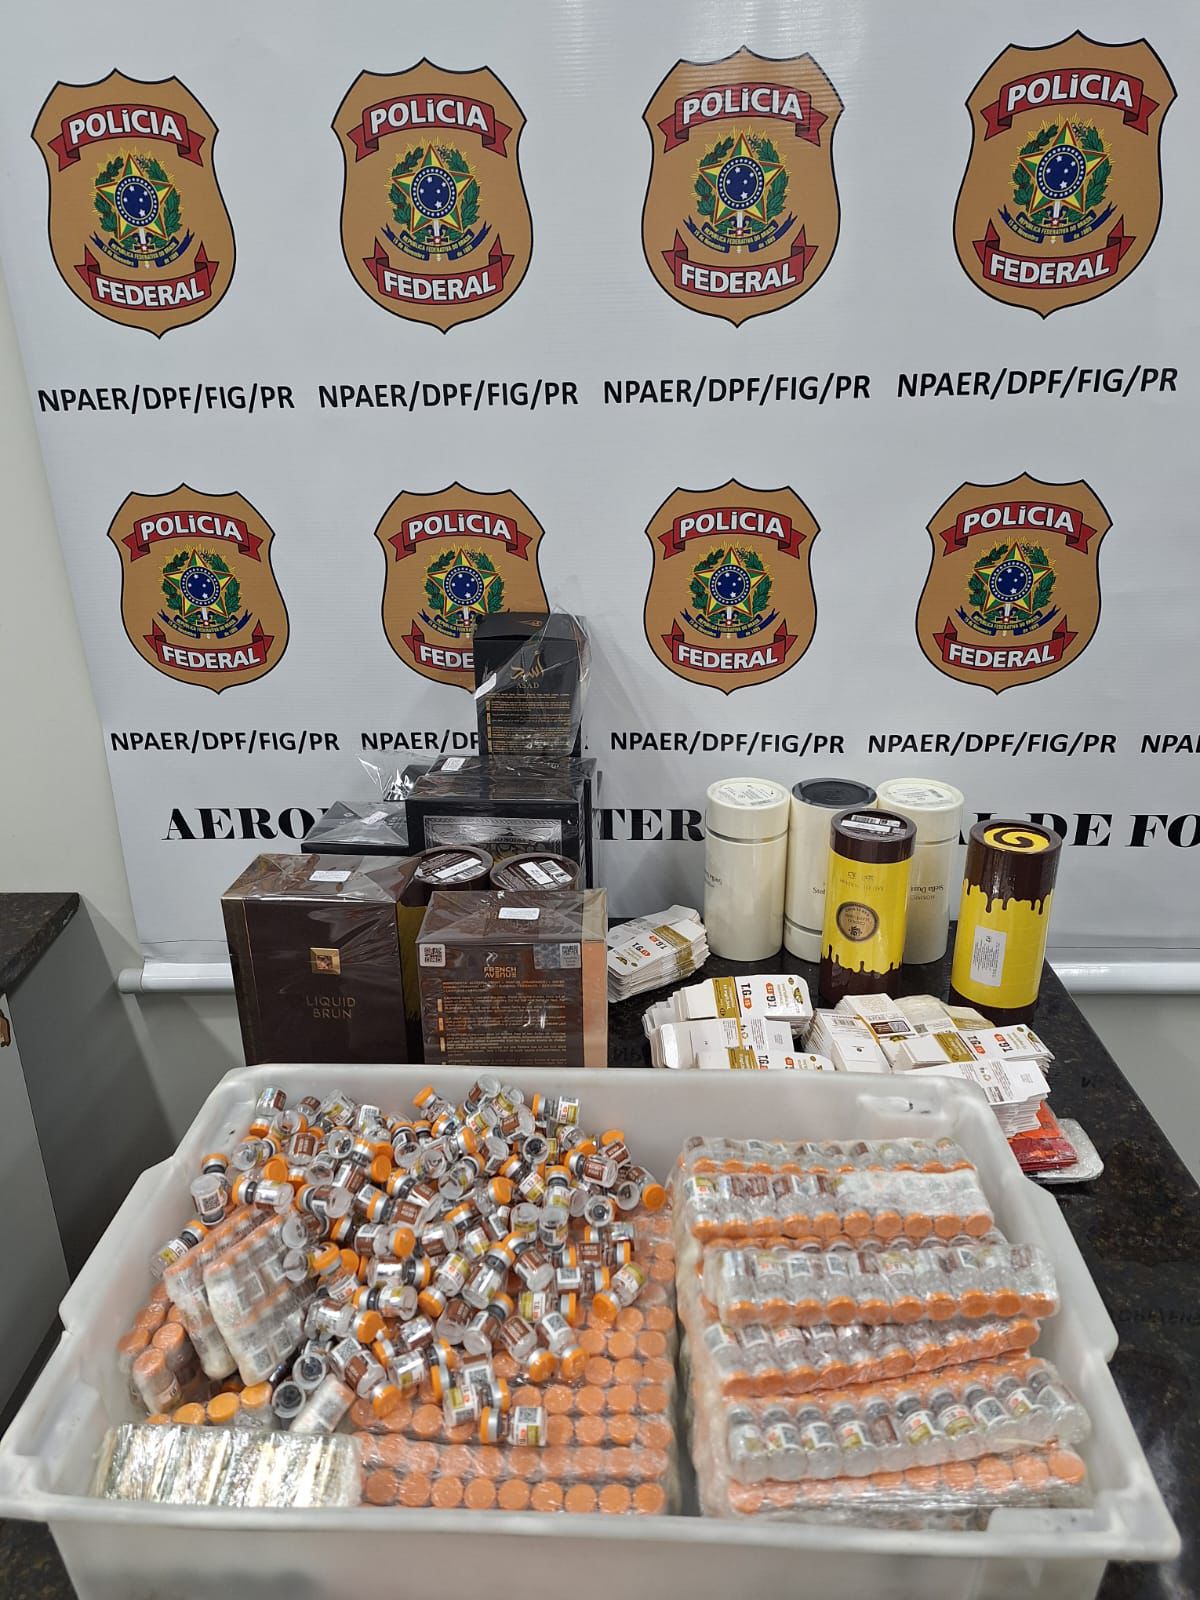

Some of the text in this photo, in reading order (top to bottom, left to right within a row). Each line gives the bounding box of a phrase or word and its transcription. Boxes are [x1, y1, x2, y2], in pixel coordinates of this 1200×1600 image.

[681, 263, 796, 293] FEDERAL
[990, 253, 1110, 284] FEDERAL
[96, 277, 204, 306] FEDERAL
[384, 270, 496, 300] FEDERAL
[318, 379, 579, 412] NPAER/DPF/FIG/PR
[603, 373, 871, 407] NPAER/DPF/FIG/PR
[897, 364, 1178, 400] NPAER/DPF/FIG/PR
[37, 382, 295, 415] NPAER/DPF/FIG/PR
[162, 645, 260, 669] FEDERAL
[420, 645, 474, 669] FEDE
[678, 645, 778, 669] FEDERAL
[949, 643, 1055, 668] FEDERAL
[110, 729, 340, 755] NPAER/DPF/FIG/PR
[610, 730, 845, 757] NPAER/DPF/FIG/PR
[868, 731, 1117, 757] NPAER/DPF/FIG/PR
[161, 807, 330, 841] AERO
[306, 996, 356, 1008] LIQUID
[313, 1009, 352, 1019] BRUN
